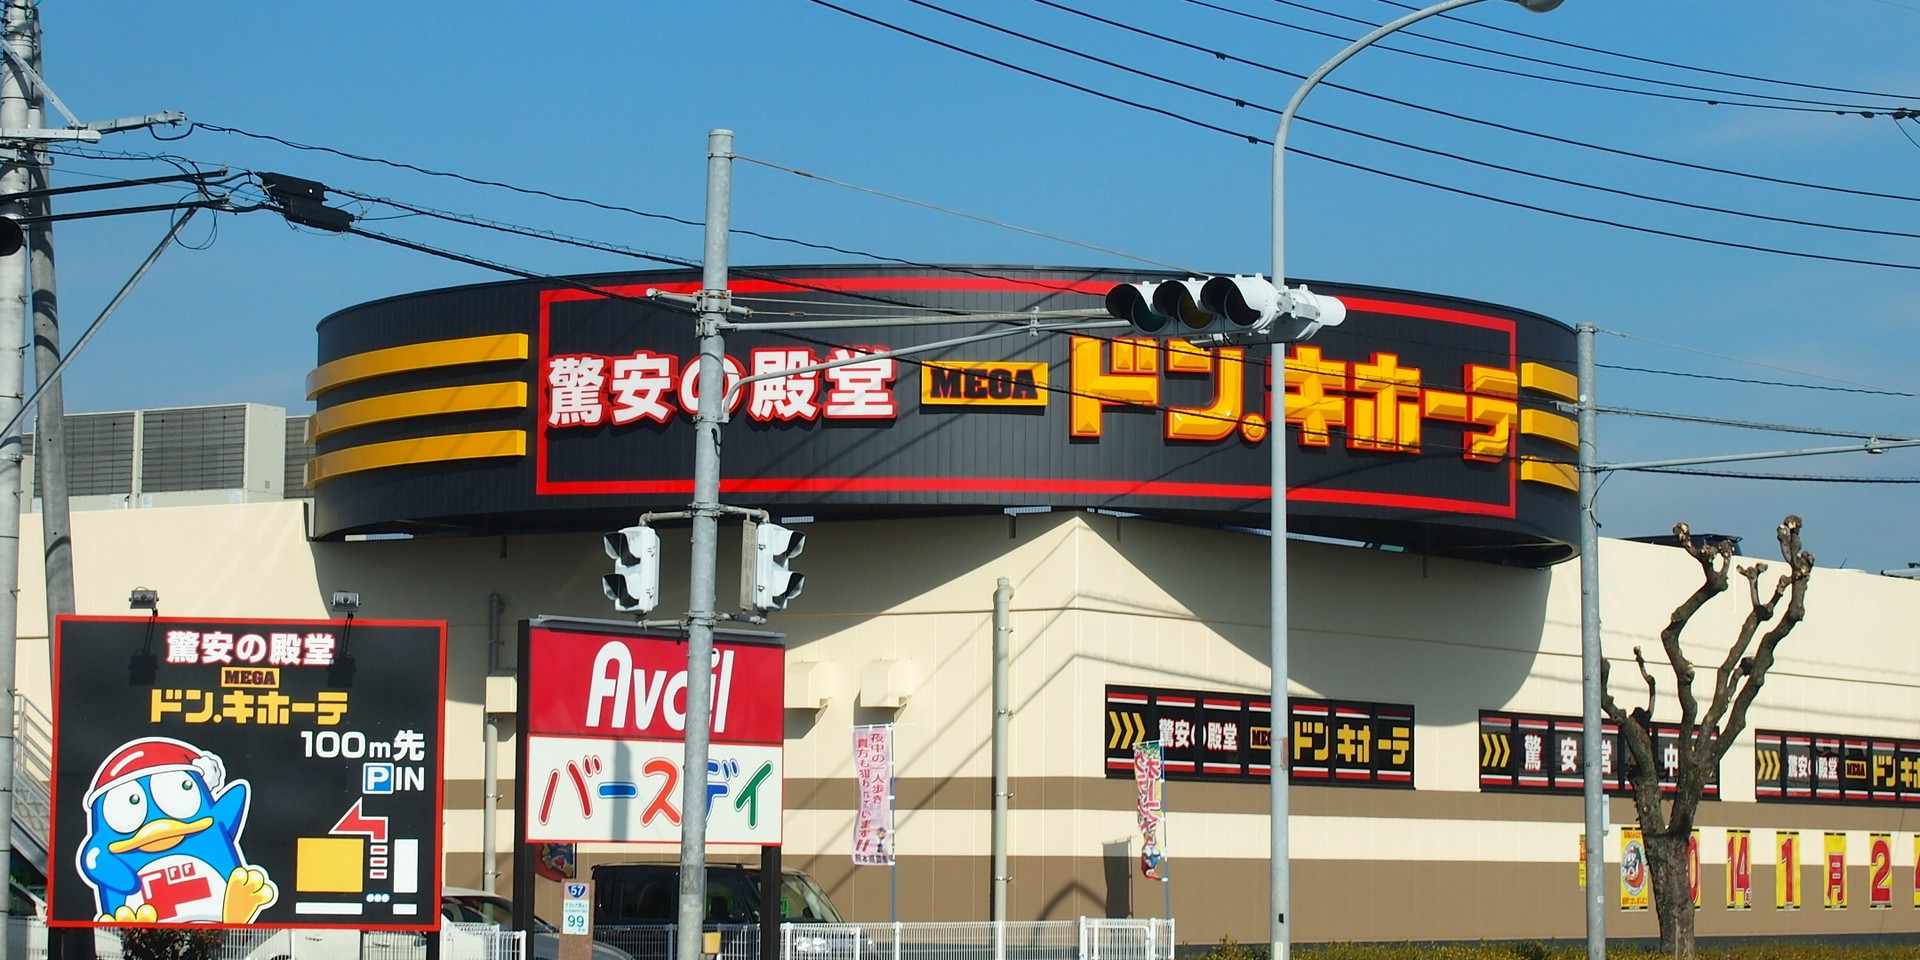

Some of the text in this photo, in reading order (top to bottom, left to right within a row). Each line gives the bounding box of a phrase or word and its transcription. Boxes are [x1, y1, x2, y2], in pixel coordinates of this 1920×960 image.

[546, 346, 897, 428] 驚安の殿堂
[931, 368, 1038, 400] MEGA
[166, 631, 336, 666] 驚安の殿堂
[224, 670, 276, 686] MEGA
[301, 730, 425, 761] 100m先
[395, 767, 425, 791] IN
[1781, 837, 1793, 904] 1
[1871, 839, 1892, 903] 2
[571, 885, 583, 896] 57
[567, 915, 585, 928] 99
